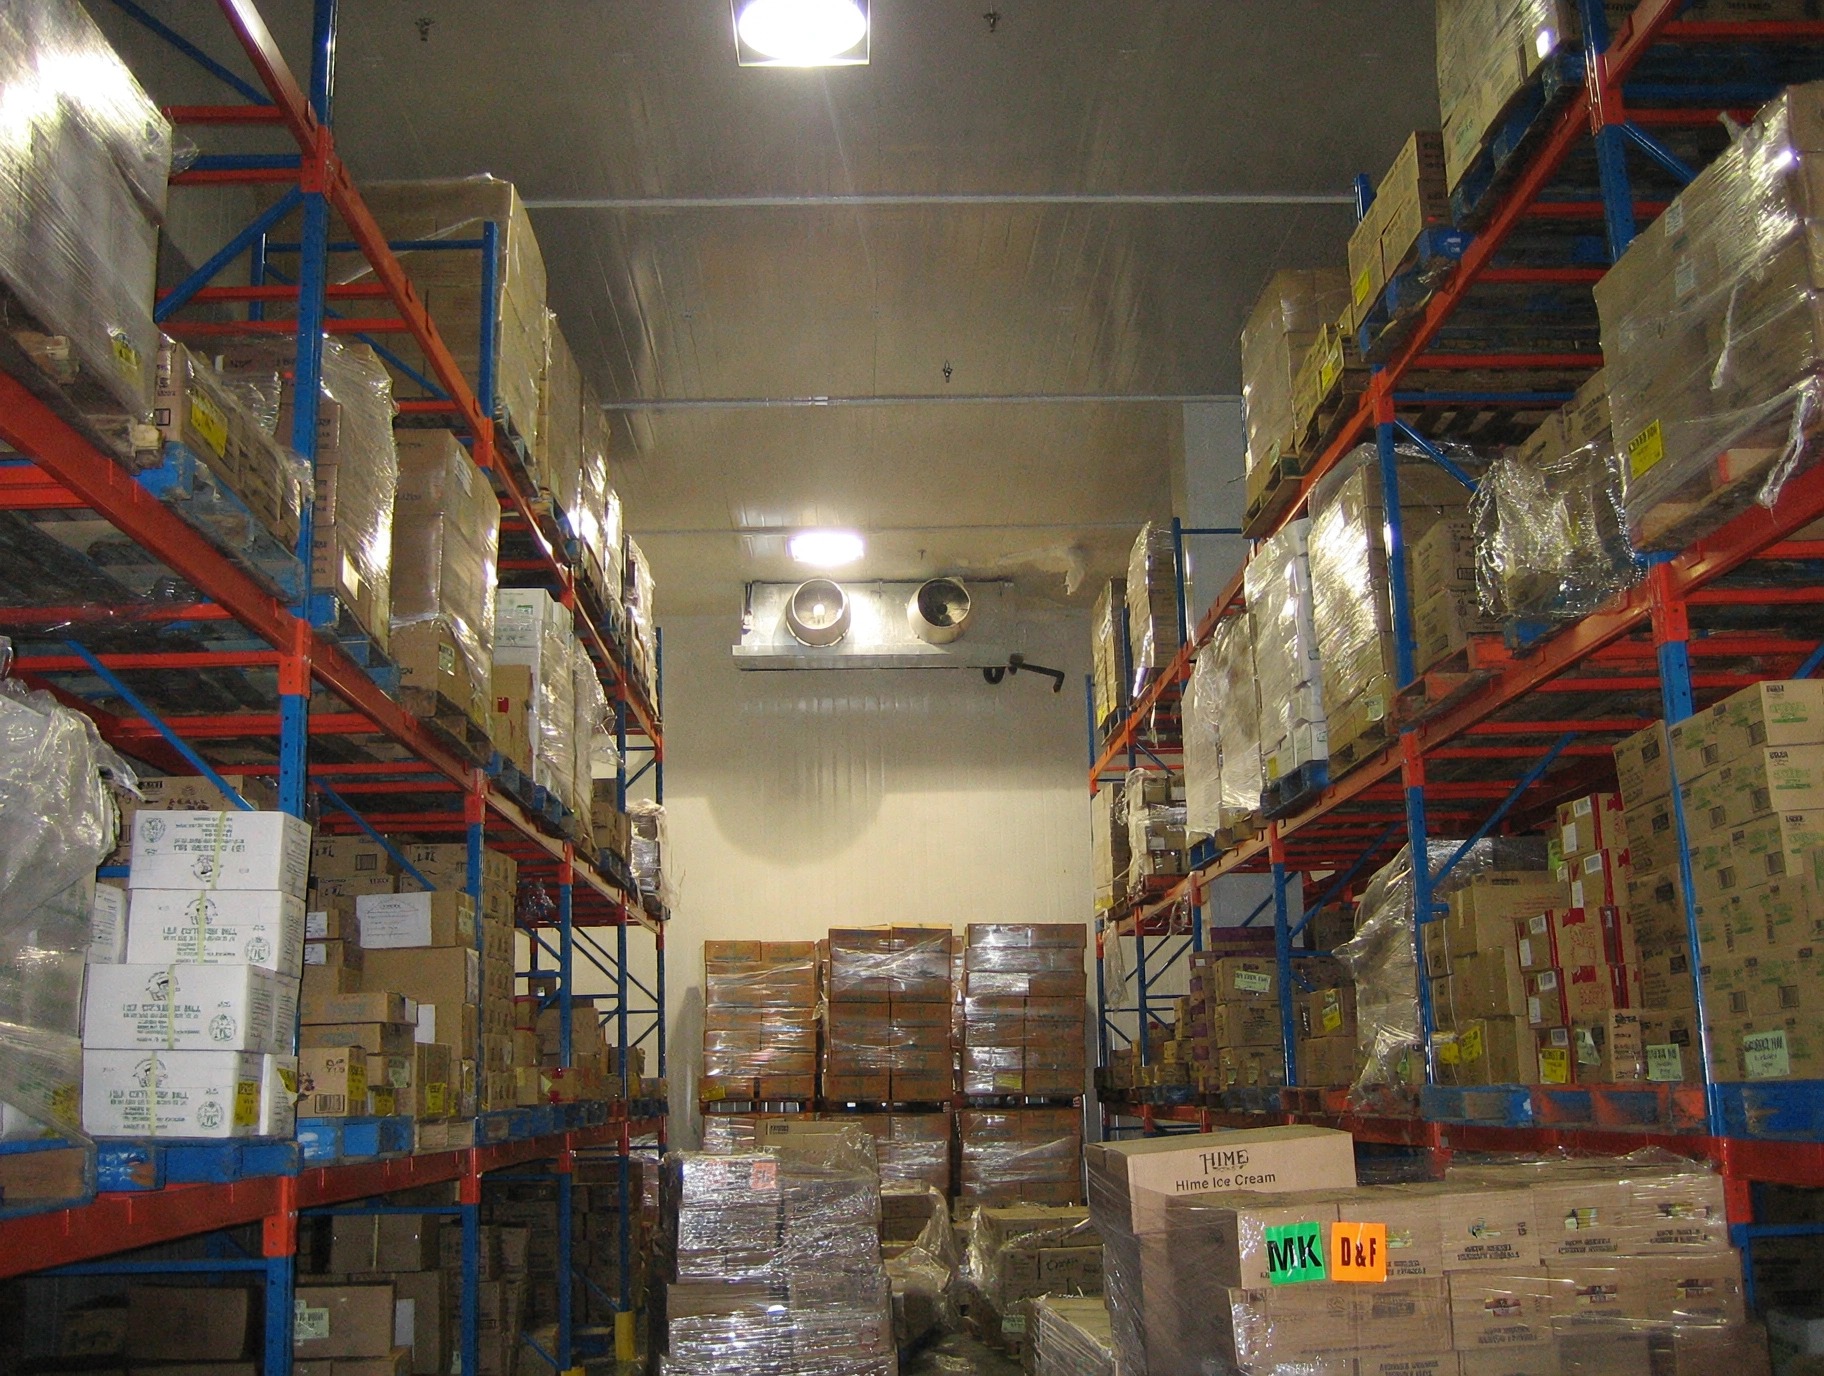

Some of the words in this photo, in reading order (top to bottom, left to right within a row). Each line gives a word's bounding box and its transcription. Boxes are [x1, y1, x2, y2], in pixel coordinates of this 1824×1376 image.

[1199, 1149, 1249, 1174] HIME
[1213, 1177, 1231, 1188] Ice
[1235, 1174, 1276, 1185] Cream
[1266, 1235, 1322, 1272] MK
